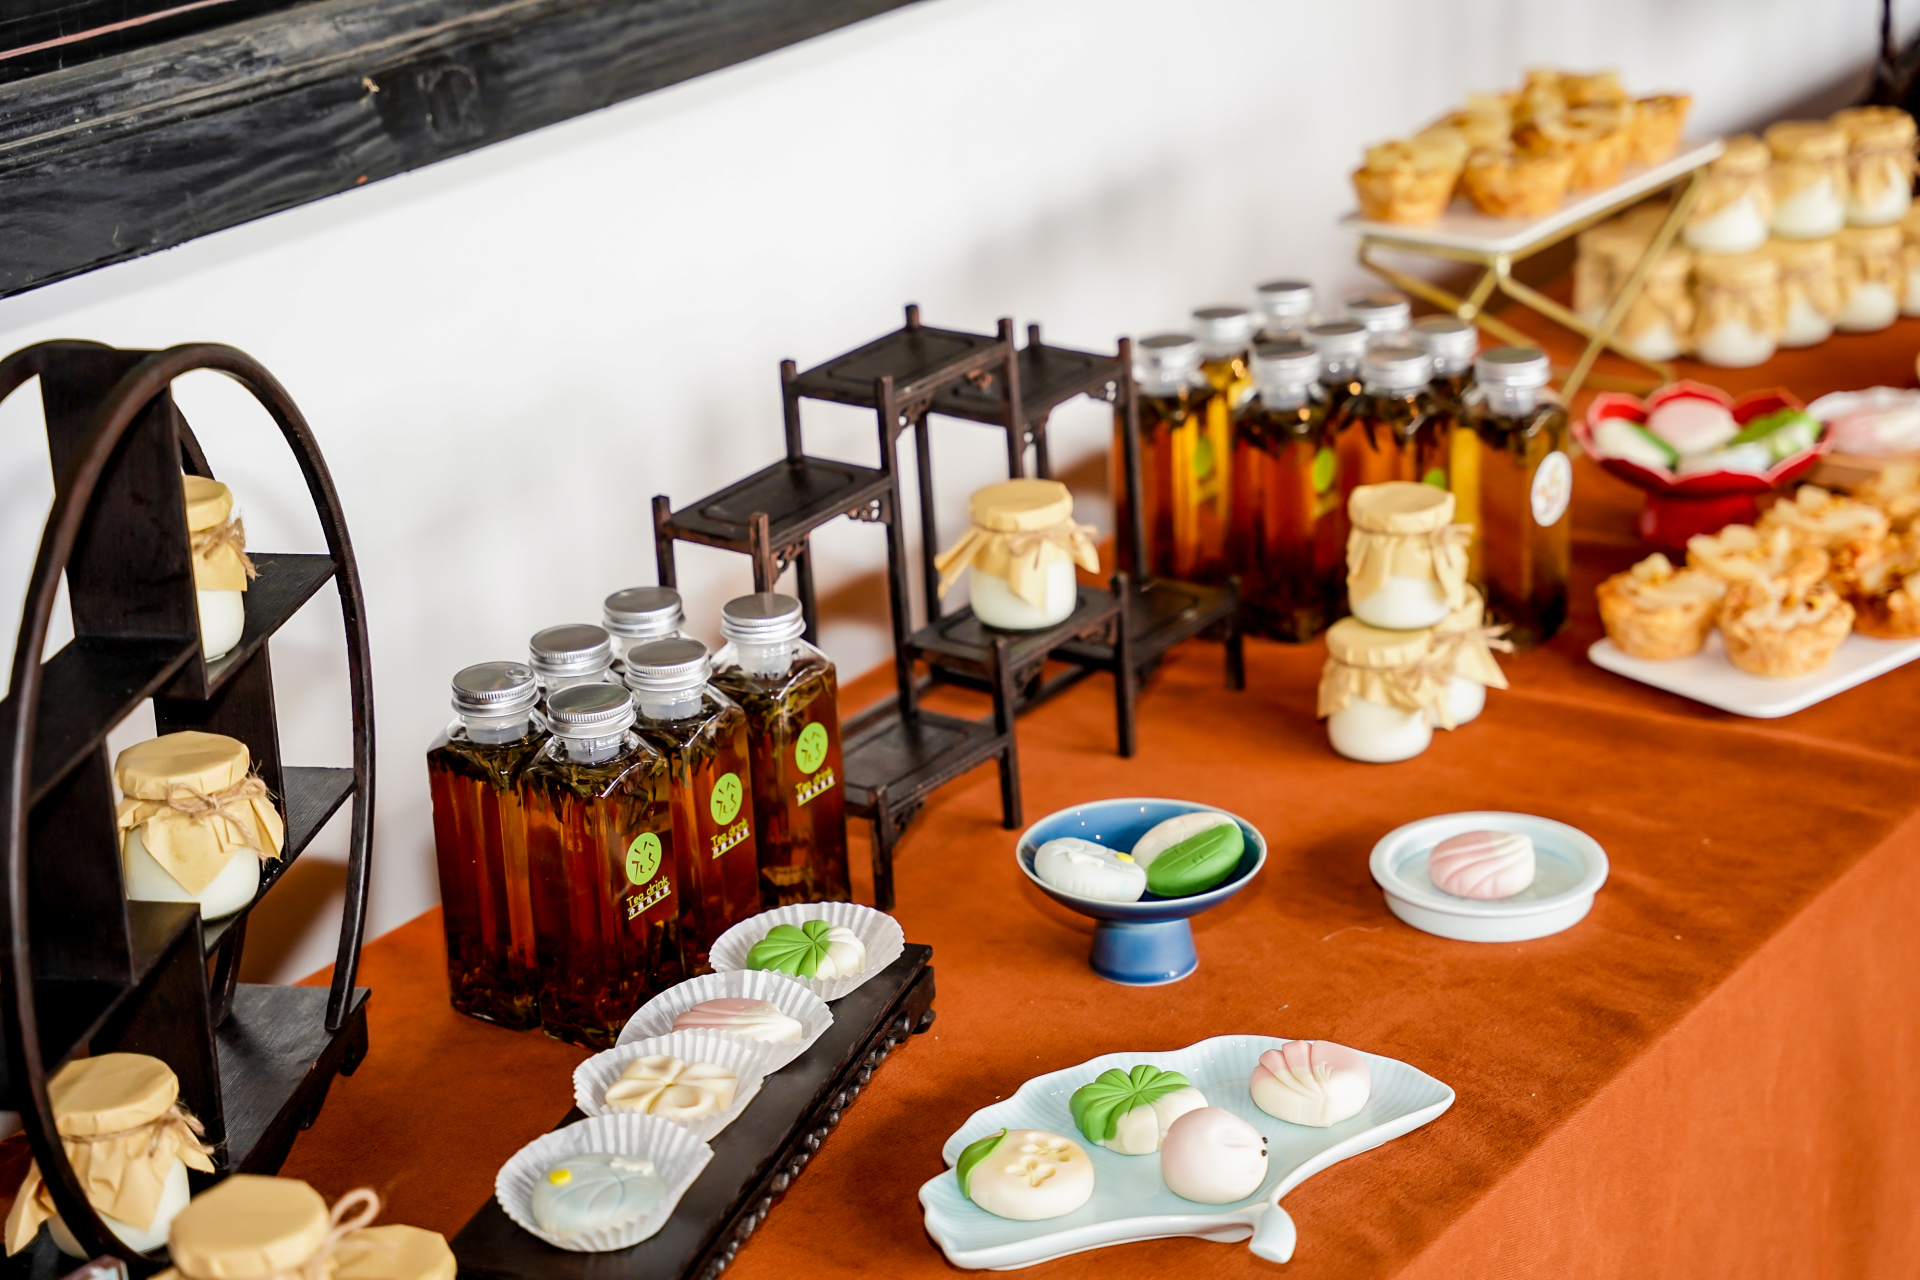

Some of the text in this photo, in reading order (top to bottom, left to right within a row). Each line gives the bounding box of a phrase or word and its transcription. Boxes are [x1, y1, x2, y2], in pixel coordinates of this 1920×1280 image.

[710, 835, 727, 847] Tea
[626, 875, 670, 907] Tea drink
